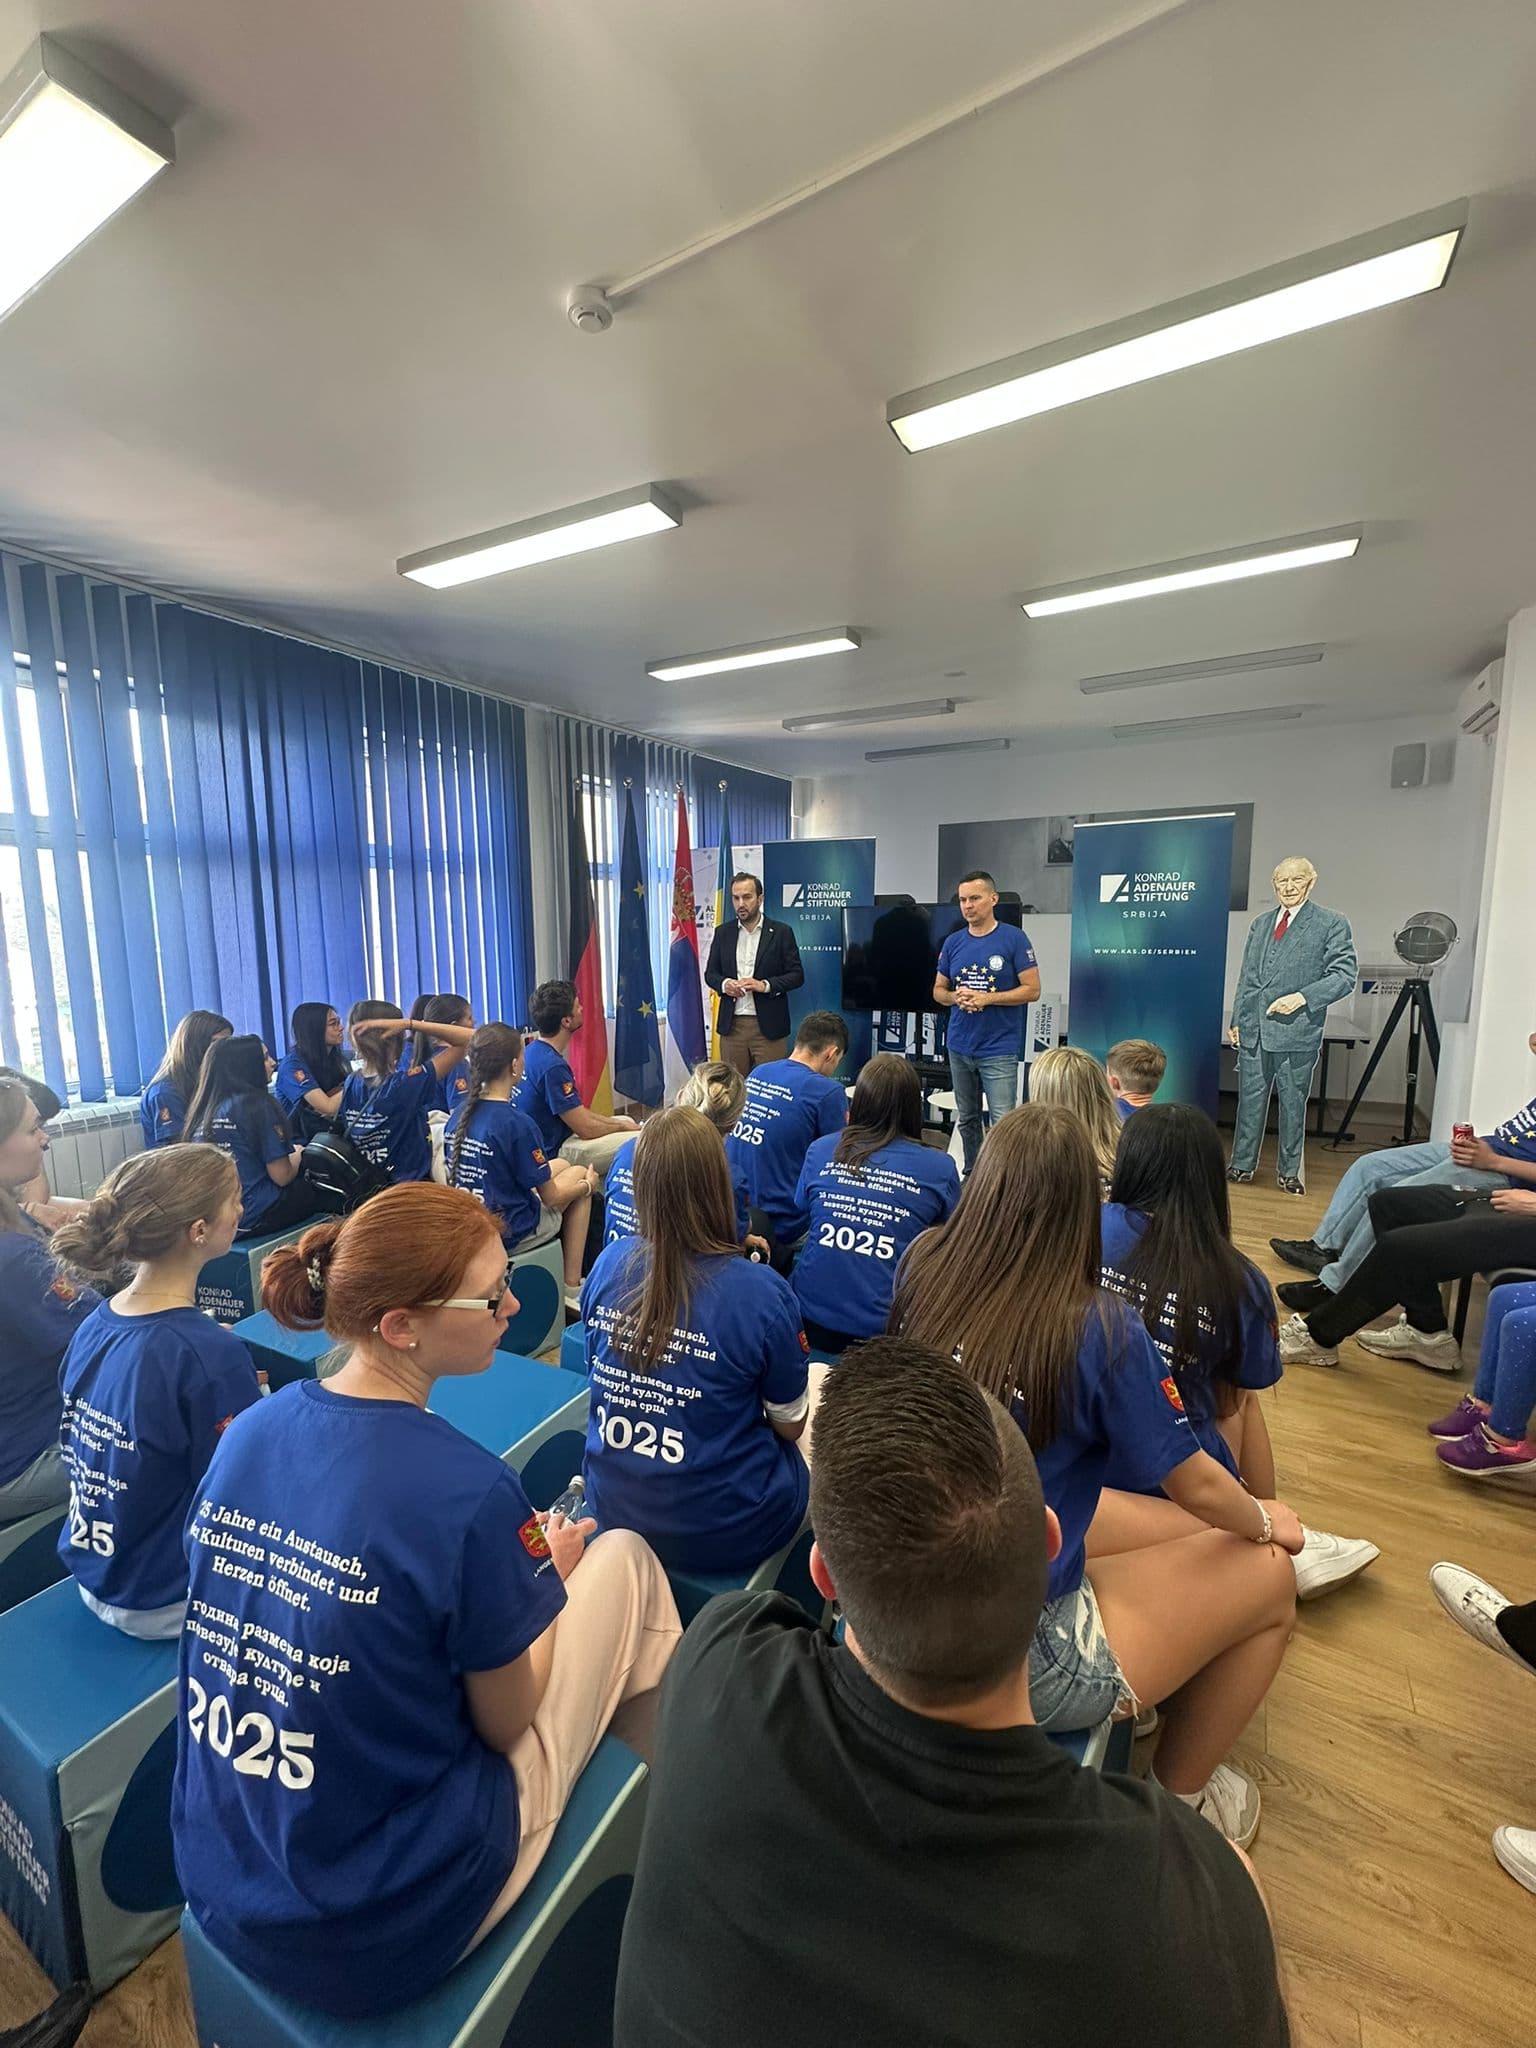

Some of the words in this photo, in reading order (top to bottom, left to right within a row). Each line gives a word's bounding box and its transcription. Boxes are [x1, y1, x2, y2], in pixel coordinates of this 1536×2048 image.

[1134, 872, 1180, 882] KONRAD
[807, 883, 841, 891] KONRAD
[1133, 881, 1196, 892] ADENAUER
[806, 891, 852, 899] ADENAUER
[1133, 892, 1189, 902] STIFTUNG
[806, 899, 847, 907] STIFTUNG
[1122, 910, 1167, 918] SRBIJA
[729, 1121, 765, 1145] 025
[818, 1222, 896, 1260] 2025
[1101, 1266, 1126, 1281] ahre
[198, 1287, 232, 1298] KONRAD
[199, 1296, 244, 1309] ADENAUER
[694, 1348, 716, 1361] und
[676, 1386, 702, 1399] која
[114, 1439, 134, 1452] und
[212, 1506, 256, 1531] Jahre
[259, 1521, 282, 1541] ein
[284, 1530, 368, 1580] Austausch,
[199, 1527, 265, 1561] Kulturen
[269, 1552, 335, 1595] verbindet
[338, 1586, 380, 1605] und
[212, 1556, 264, 1588] Herzen
[268, 1574, 312, 1612] öffnet.
[192, 1600, 240, 1632] година
[241, 1622, 304, 1663] размена
[308, 1653, 351, 1675] која
[244, 1647, 305, 1687] културе
[309, 1679, 321, 1694] и
[203, 1652, 249, 1686] отвара
[254, 1675, 289, 1708] срца.
[188, 1677, 315, 1790] 2025
